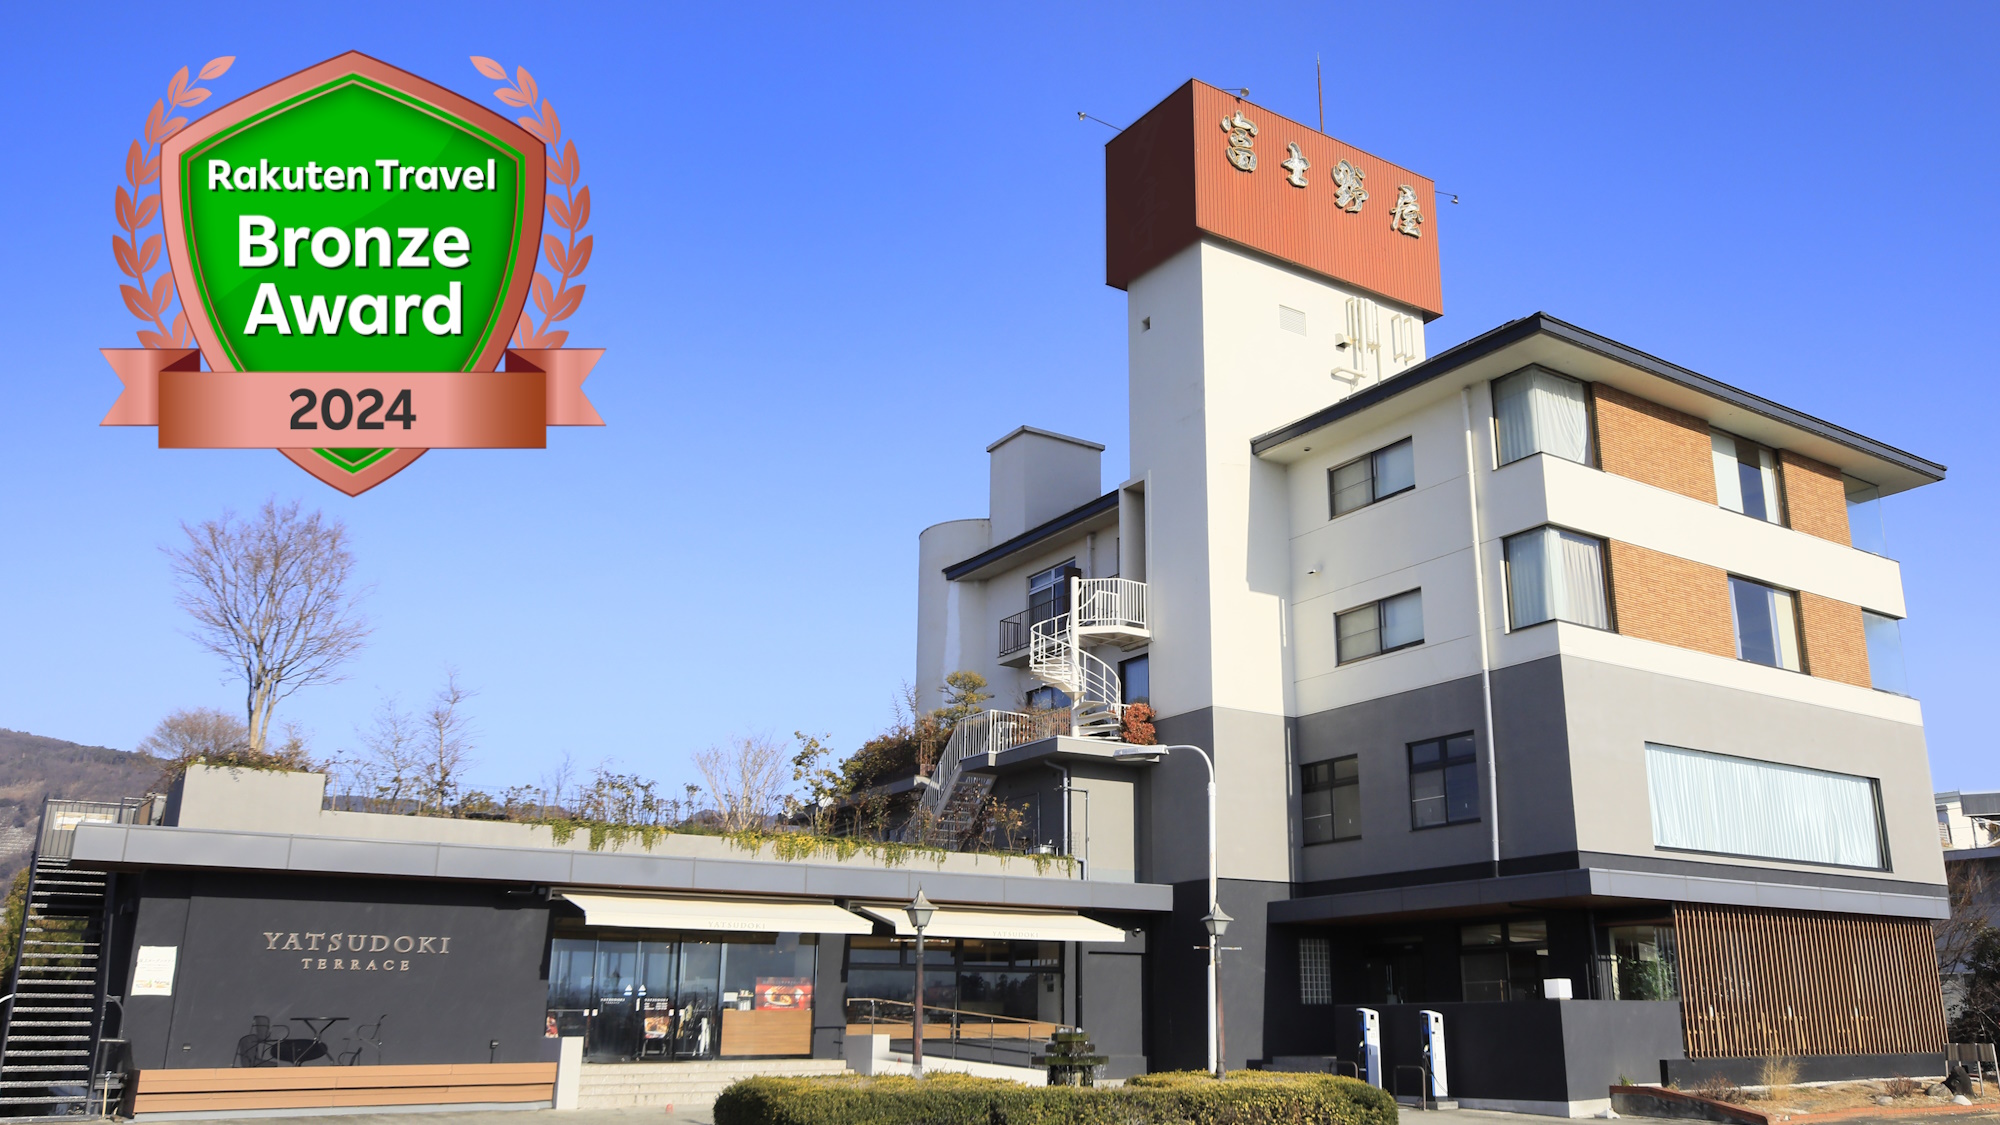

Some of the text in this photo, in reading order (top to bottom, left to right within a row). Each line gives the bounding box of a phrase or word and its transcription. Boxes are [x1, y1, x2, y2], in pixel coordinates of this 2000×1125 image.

[1220, 110, 1424, 238] 富士野屋
[707, 920, 768, 930] YATSUDOKI
[992, 930, 1040, 938] YATSUDOKI
[263, 932, 451, 954] YATSUDOKI
[301, 958, 410, 971] TERRACE
